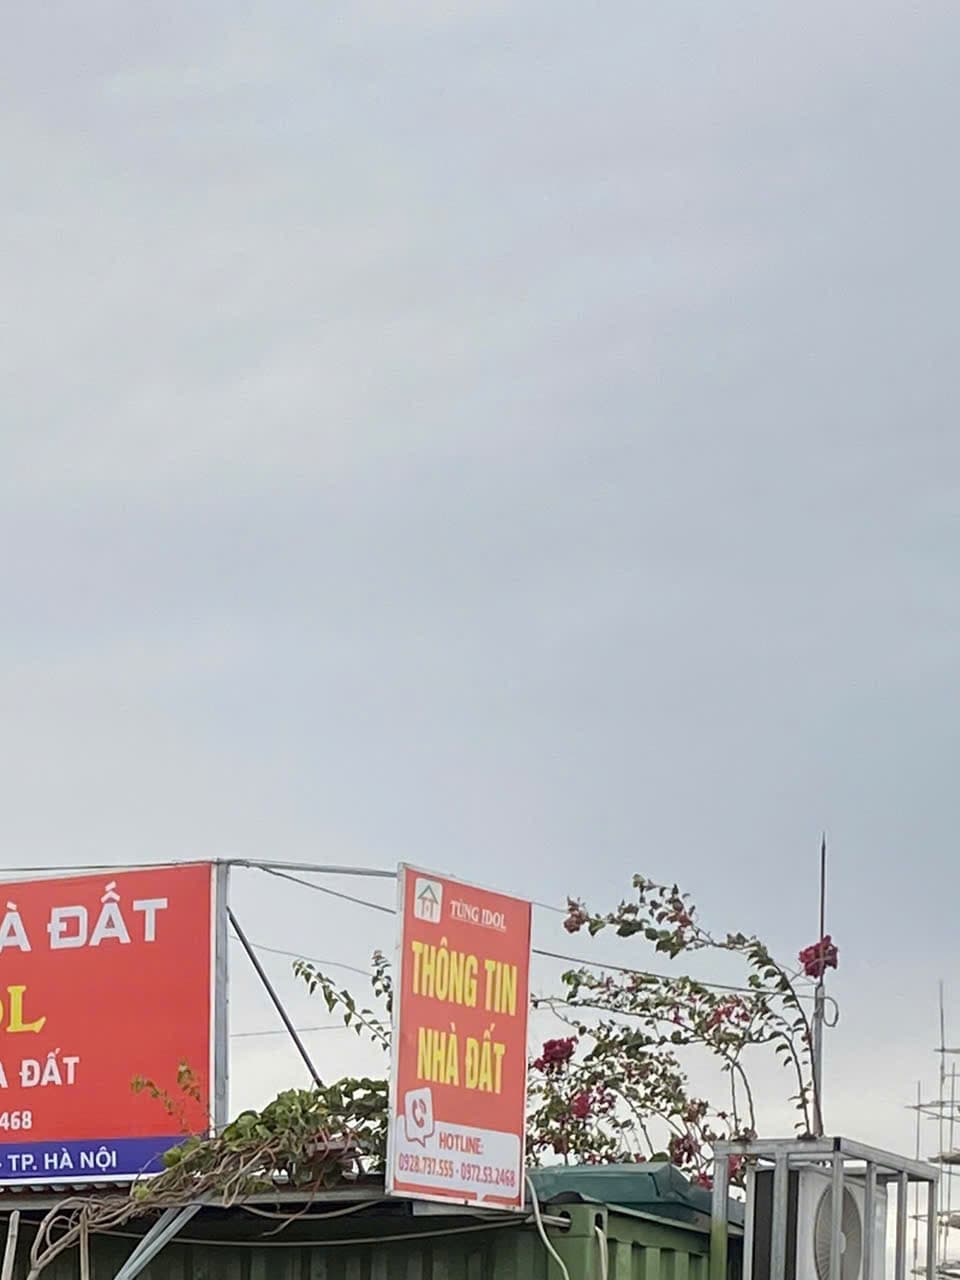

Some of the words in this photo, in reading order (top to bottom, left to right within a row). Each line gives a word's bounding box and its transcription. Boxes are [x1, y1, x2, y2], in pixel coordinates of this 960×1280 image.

[47, 881, 168, 950] ĐẤT
[449, 898, 479, 922] TÙNG
[481, 908, 507, 929] IDOL
[411, 936, 479, 1009] THÔNG
[484, 959, 517, 1016] TIN
[19, 1048, 80, 1088] ĐẤT
[417, 1022, 460, 1087] NHÀ
[465, 1023, 506, 1095] ĐẤT
[8, 1153, 37, 1172] TP.
[44, 1147, 73, 1171] HÀ
[80, 1146, 117, 1172] NỘI
[399, 1152, 454, 1178] 0928.737.555
[460, 1161, 516, 1188] 0972.53.2468
